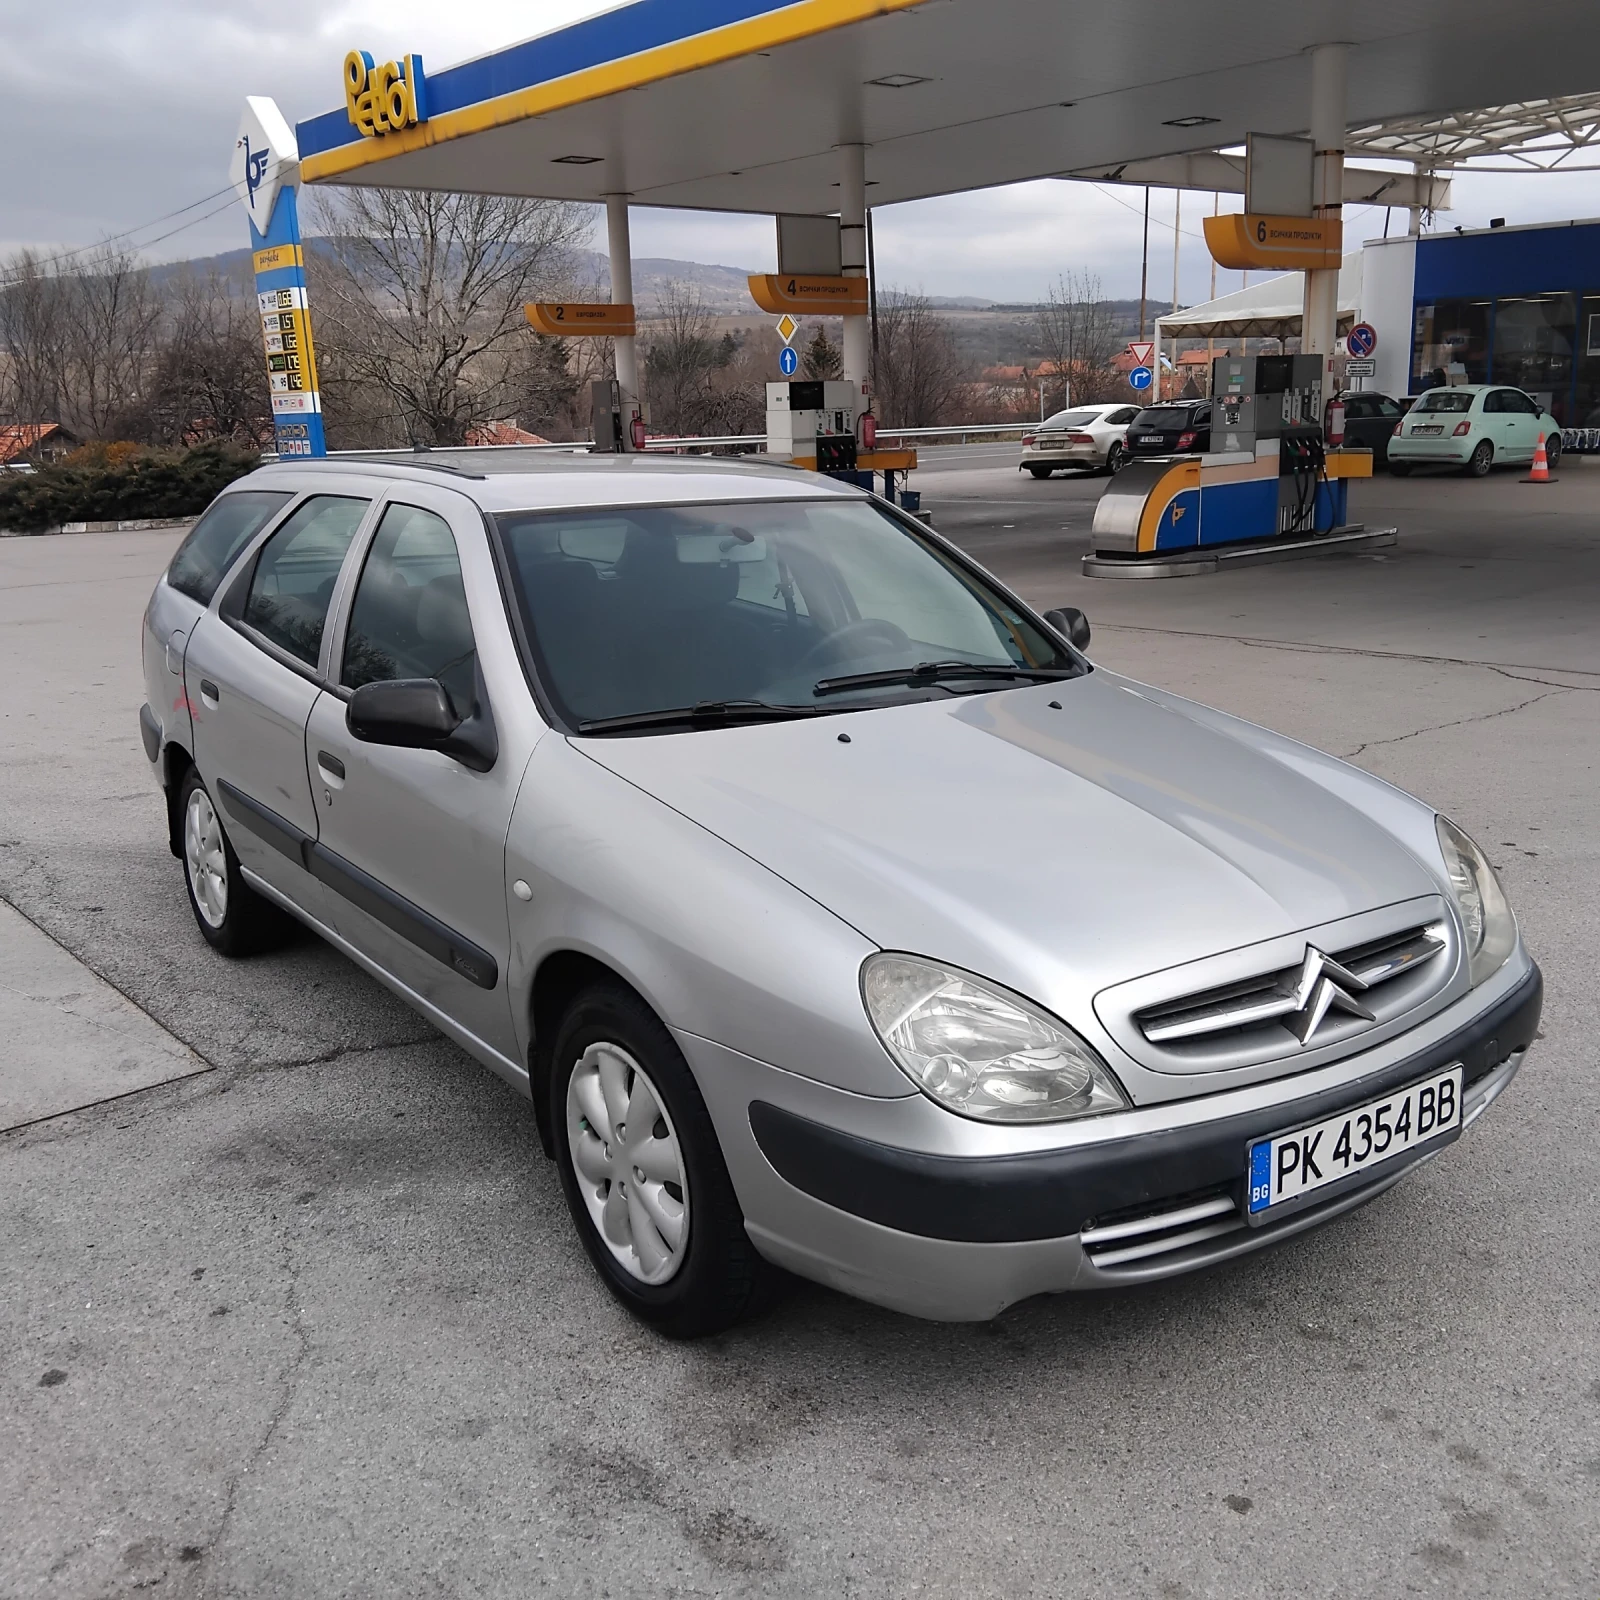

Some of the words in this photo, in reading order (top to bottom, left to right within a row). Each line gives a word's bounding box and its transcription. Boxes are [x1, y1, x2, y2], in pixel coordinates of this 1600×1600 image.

[344, 50, 423, 137] Petrol
[1257, 220, 1267, 242] 6
[1270, 230, 1293, 239] ВСИЧКИ
[1293, 231, 1322, 240] ПРОДУКТИ
[787, 279, 797, 296] 4
[799, 285, 820, 293] ВСИЧКИ
[555, 306, 565, 320] 2
[1277, 1129, 1324, 1195] PK
[1332, 1096, 1412, 1169] 4354
[1417, 1078, 1455, 1137] BB
[1252, 1184, 1269, 1203] BG
